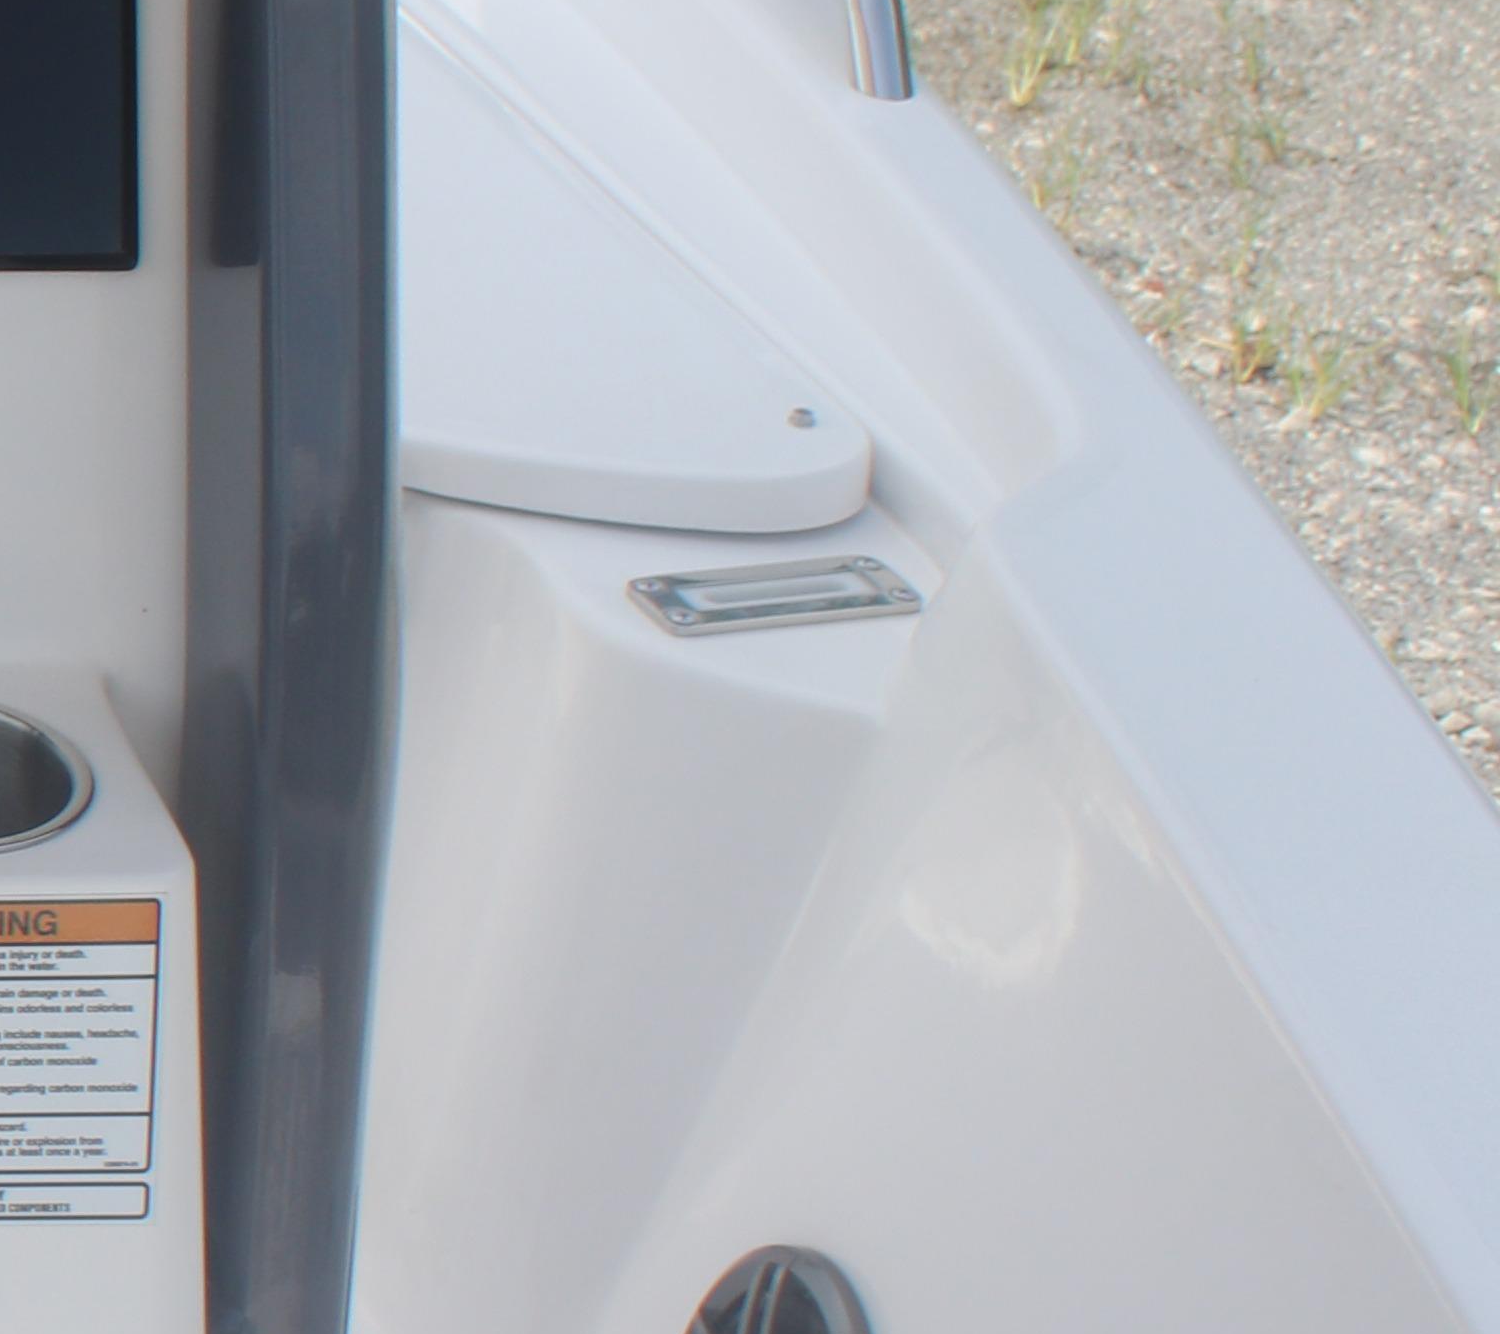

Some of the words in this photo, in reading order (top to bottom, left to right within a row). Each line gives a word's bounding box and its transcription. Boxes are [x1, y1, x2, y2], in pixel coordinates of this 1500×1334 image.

[10, 952, 38, 961] injury
[56, 950, 85, 959] death.
[9, 962, 25, 971] the
[28, 962, 60, 972] water.
[18, 990, 59, 1000] damage
[75, 989, 106, 997] death.
